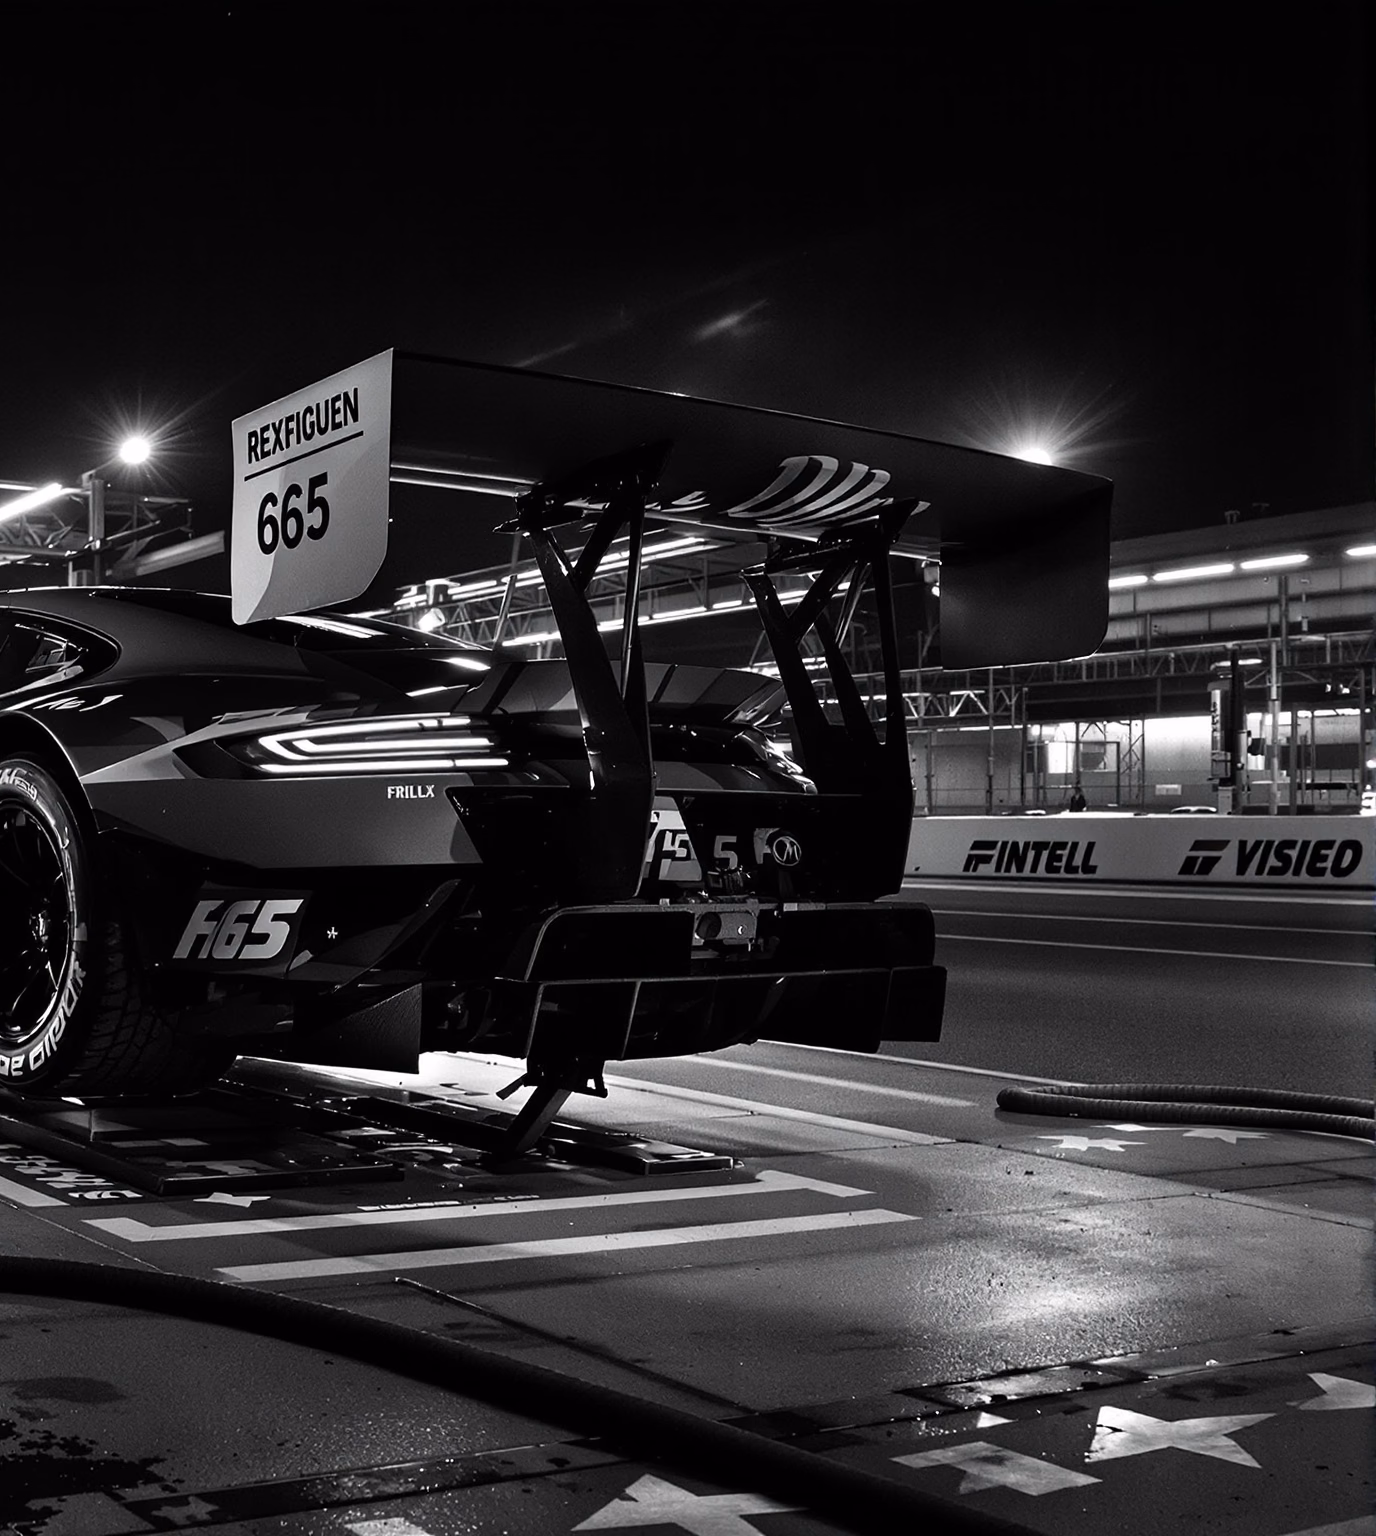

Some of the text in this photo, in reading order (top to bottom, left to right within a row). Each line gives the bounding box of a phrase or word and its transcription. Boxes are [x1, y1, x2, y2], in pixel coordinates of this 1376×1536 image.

[247, 387, 360, 464] REXFIGUEN
[257, 471, 330, 555] 665
[387, 784, 435, 799] FRILLX
